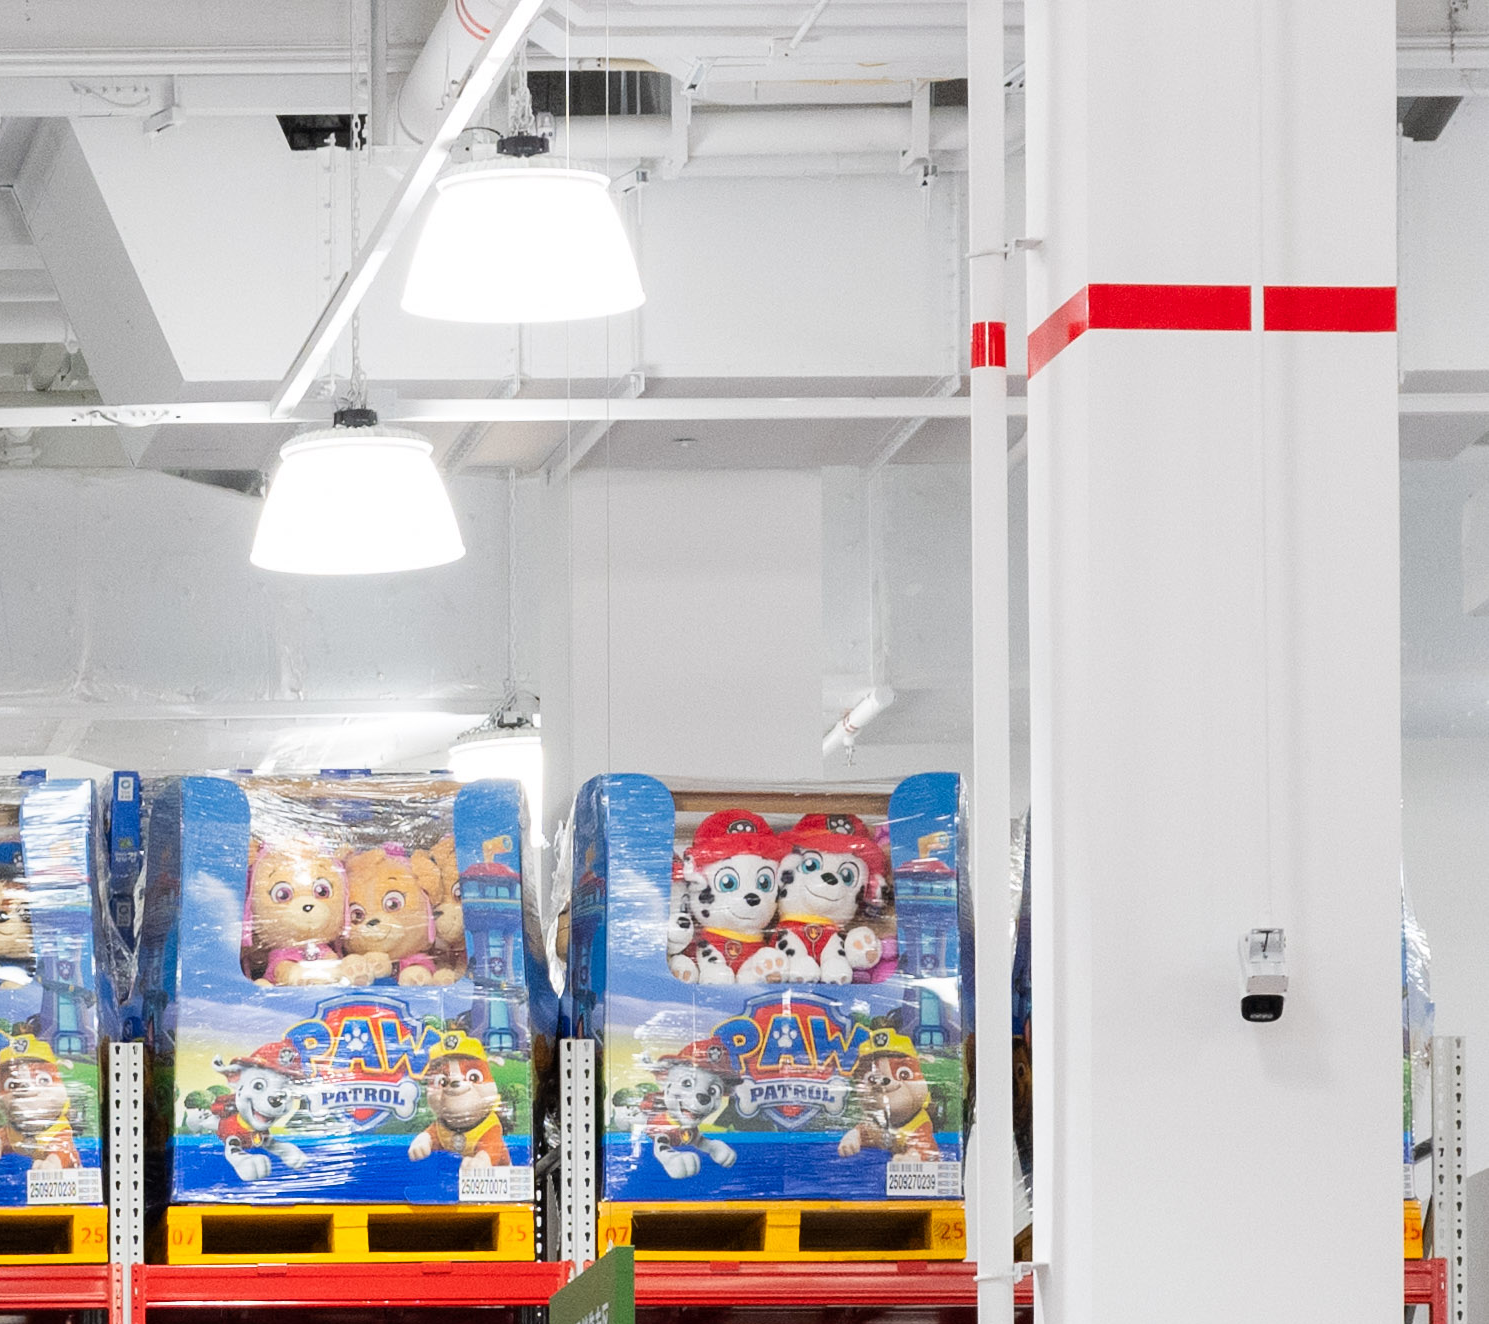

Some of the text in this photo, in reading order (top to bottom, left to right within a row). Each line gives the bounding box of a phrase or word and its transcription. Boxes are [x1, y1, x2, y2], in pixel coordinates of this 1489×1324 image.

[289, 1016, 445, 1077] PAW
[707, 1013, 872, 1072] PAW
[319, 1088, 406, 1109] PATROL
[749, 1084, 836, 1105] PATROL
[30, 1180, 77, 1197] 2509270238
[941, 1223, 964, 1241] 25
